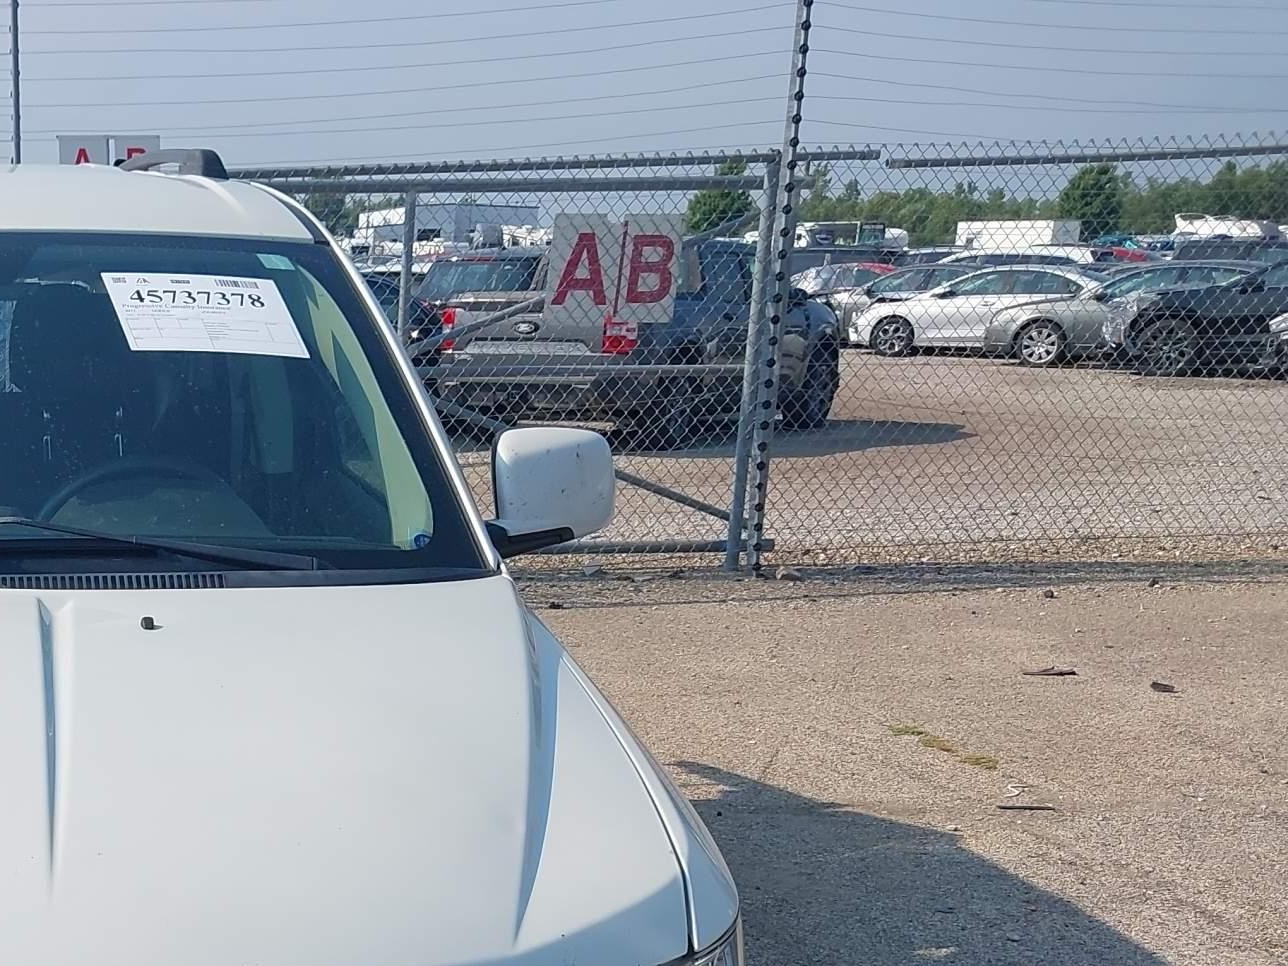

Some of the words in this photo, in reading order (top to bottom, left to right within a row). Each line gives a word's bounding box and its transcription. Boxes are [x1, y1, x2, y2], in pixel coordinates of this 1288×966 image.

[551, 232, 608, 306] A
[625, 234, 675, 304] B
[129, 289, 265, 308] 45737378
